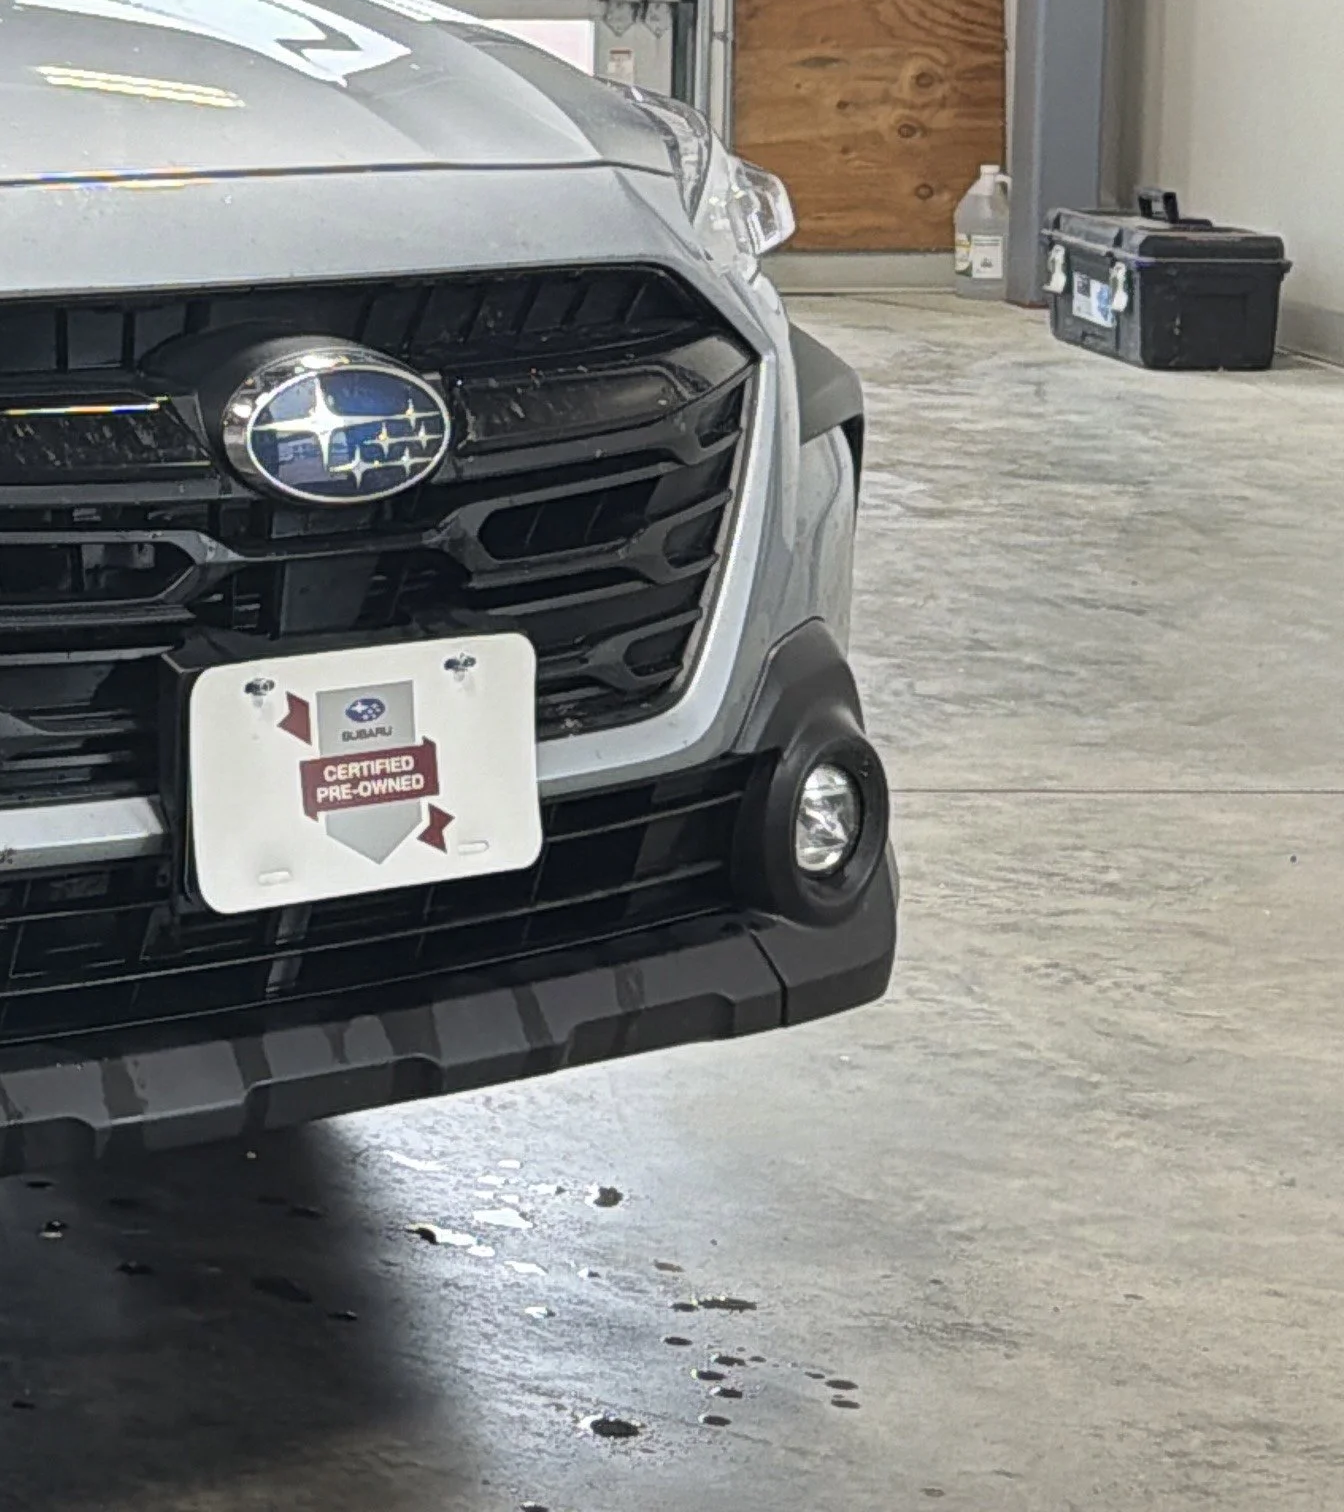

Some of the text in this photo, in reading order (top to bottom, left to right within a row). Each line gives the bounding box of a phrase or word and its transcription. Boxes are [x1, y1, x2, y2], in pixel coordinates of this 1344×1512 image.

[341, 726, 393, 742] SUBARU
[323, 755, 415, 782] CERTIFIED
[316, 773, 424, 804] PRE-OWNED
